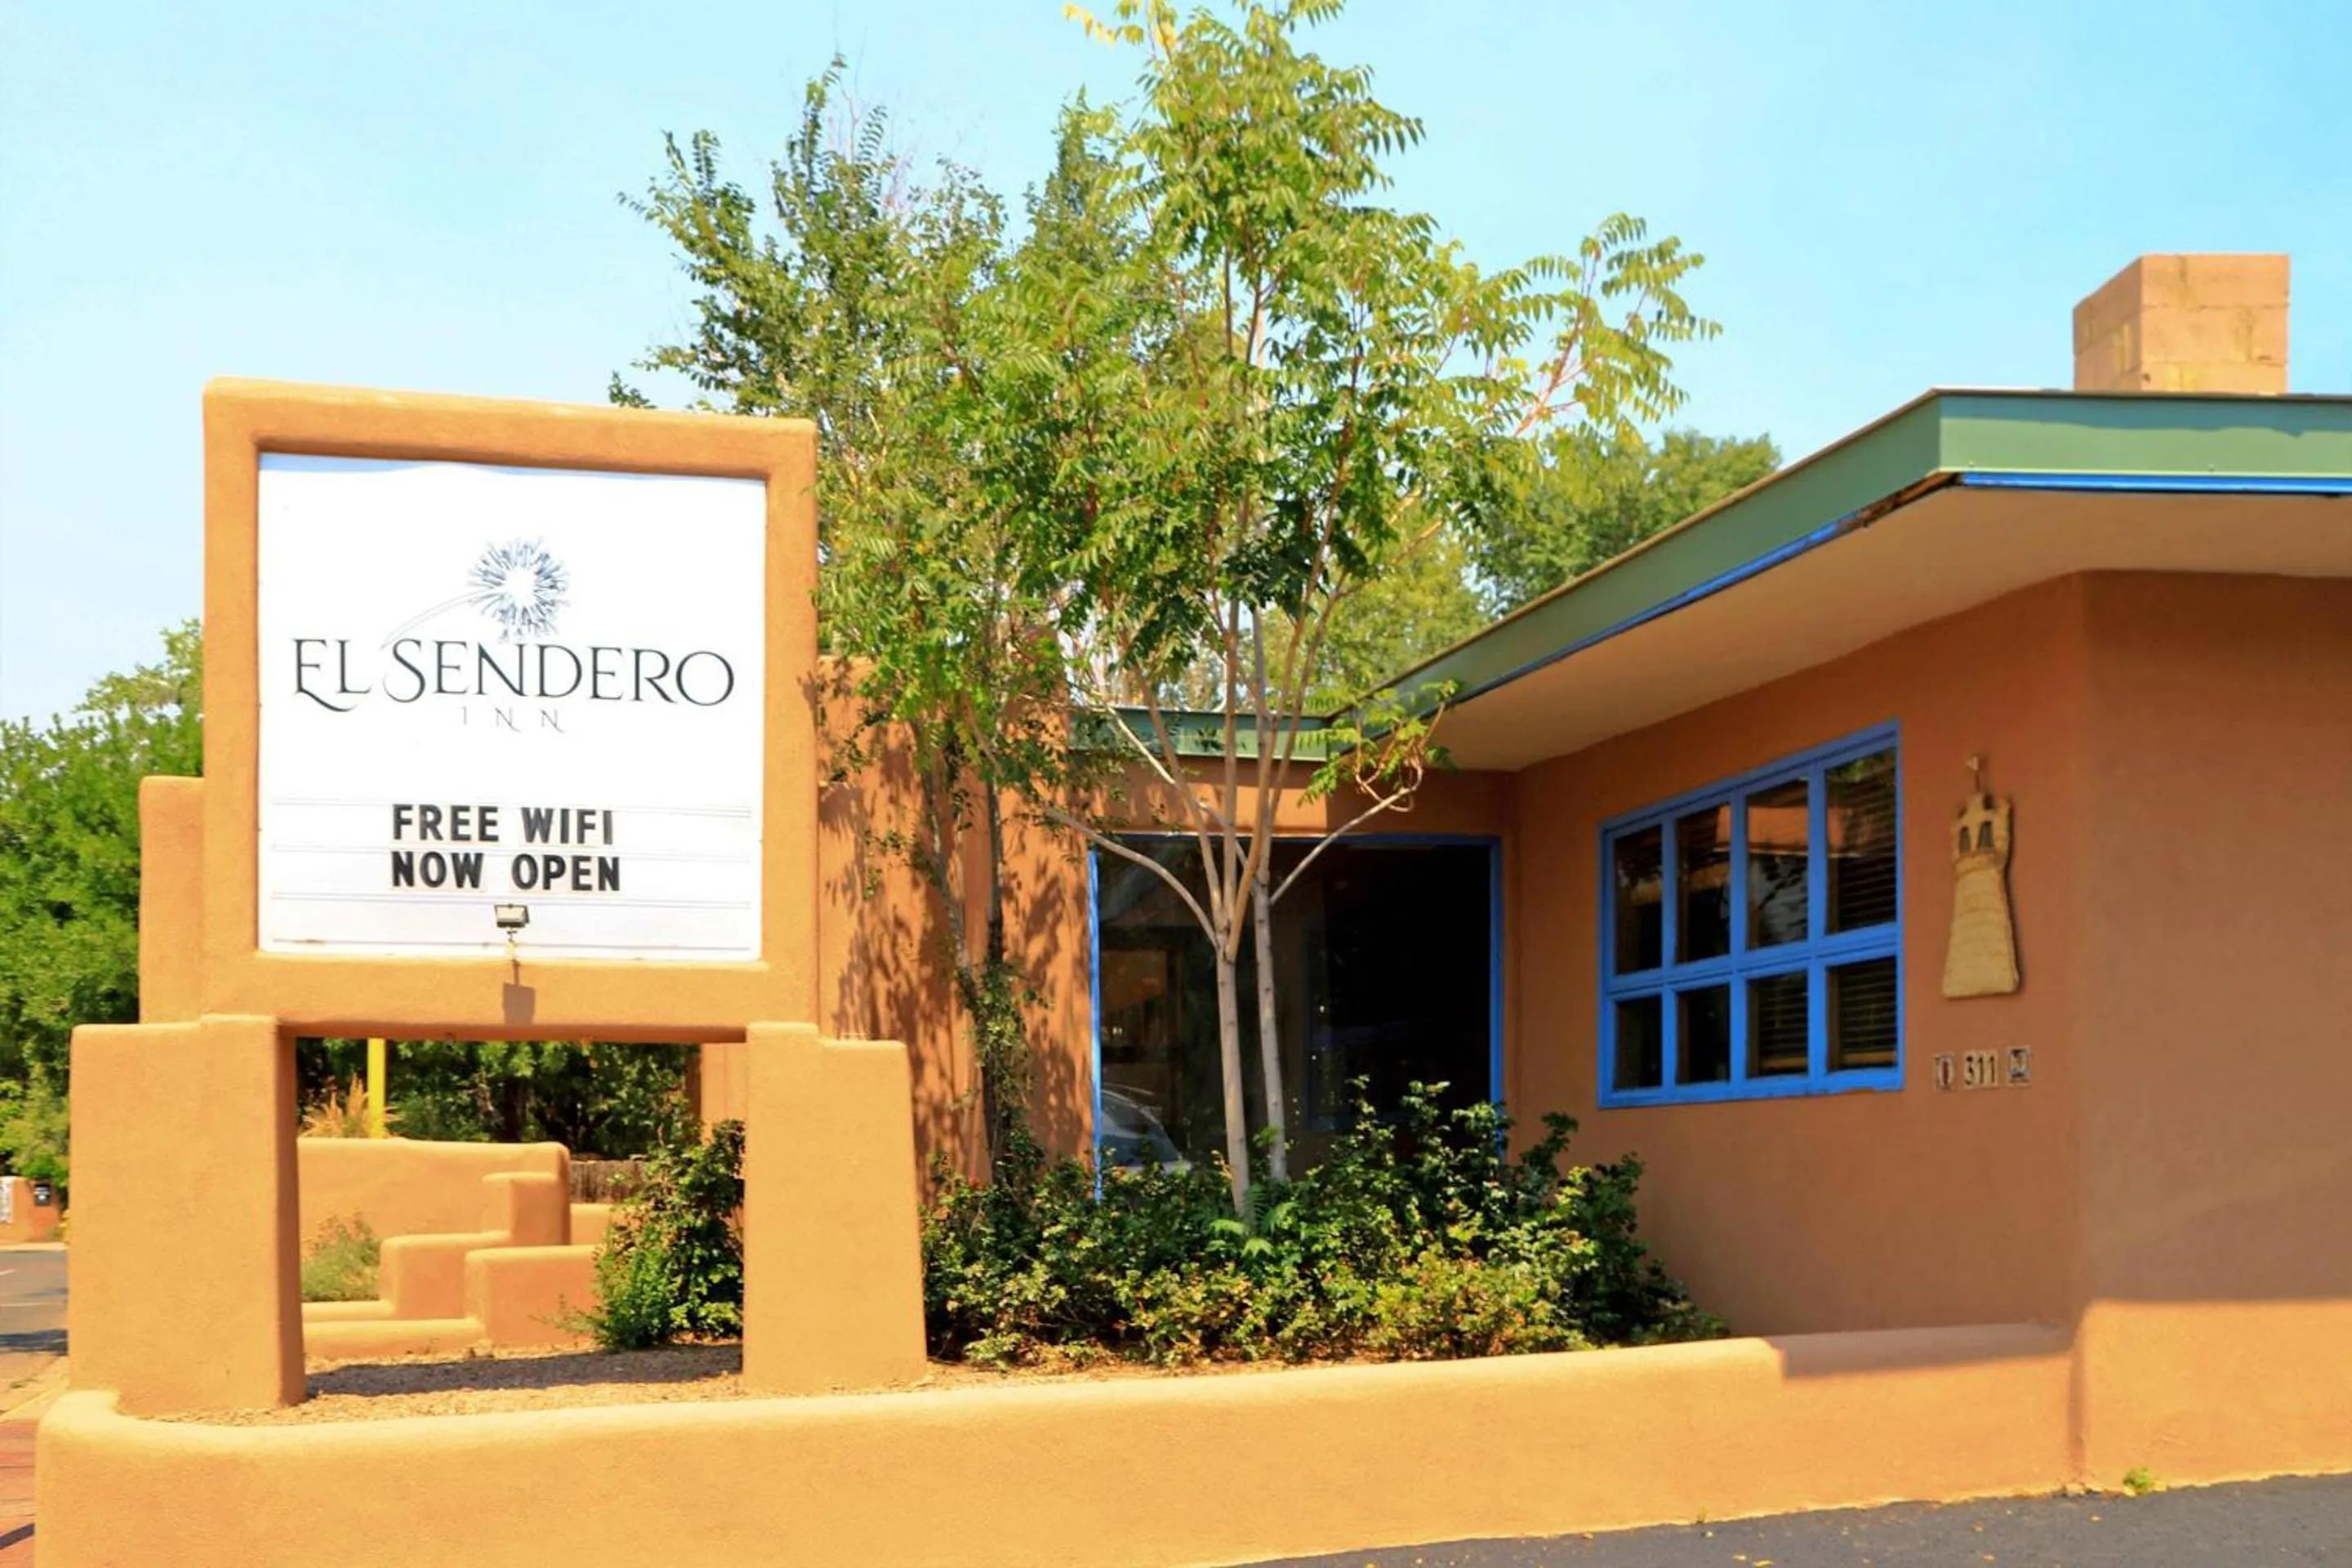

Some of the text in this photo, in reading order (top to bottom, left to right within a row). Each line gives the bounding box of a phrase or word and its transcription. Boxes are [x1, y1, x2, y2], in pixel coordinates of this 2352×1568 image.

[292, 639, 734, 712] EL SENDERO
[461, 706, 564, 733] INN
[393, 804, 613, 844] FREE WIFI
[393, 851, 620, 891] NOW OPEN
